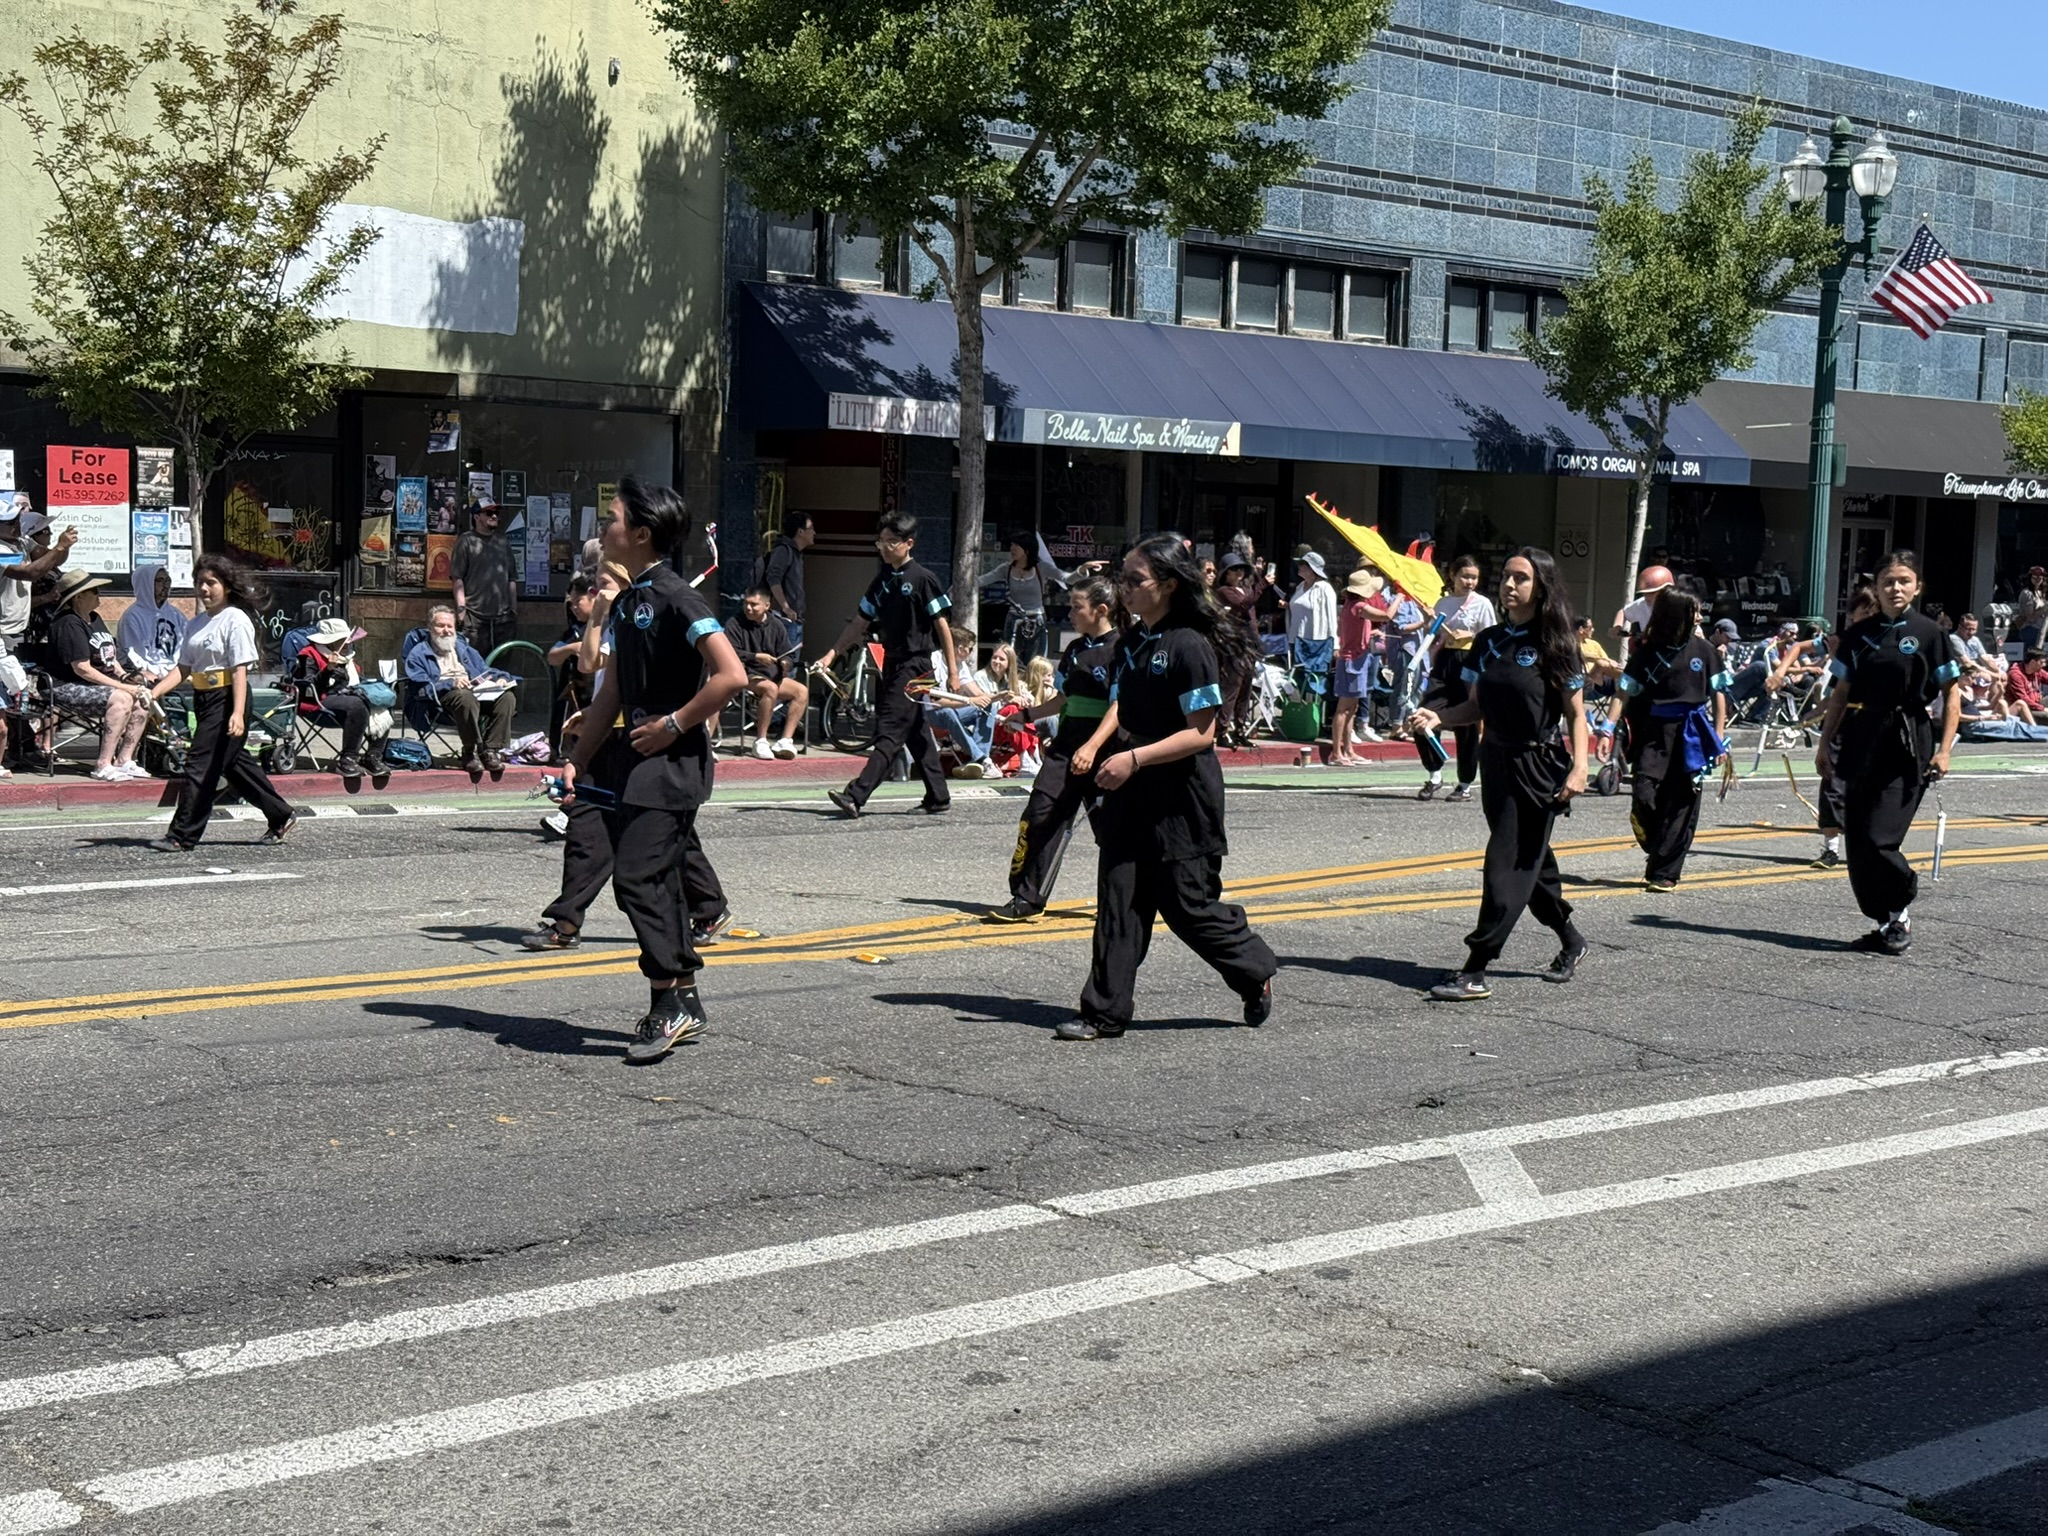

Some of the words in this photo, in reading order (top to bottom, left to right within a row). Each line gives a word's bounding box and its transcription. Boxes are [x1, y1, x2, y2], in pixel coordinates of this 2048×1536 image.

[1048, 413, 1090, 441] Bella
[1092, 416, 1129, 445] Nail
[1129, 422, 1155, 449] Spa
[1158, 421, 1171, 447] &
[1172, 424, 1220, 454] Waxing
[71, 449, 106, 467] For
[1556, 453, 1598, 471] TOMO'S
[1602, 456, 1648, 475] ORGA
[1655, 460, 1679, 475] NAIL
[1681, 461, 1701, 477] SPA
[59, 468, 118, 486] Lease
[52, 489, 125, 501] 415.395.7262
[1943, 472, 2004, 499] Triumphant
[2003, 477, 2025, 502] Life
[2025, 479, 2048, 499] Chu
[57, 514, 79, 522] ustin
[81, 514, 102, 523] Choi
[1066, 525, 1094, 543] TK
[114, 562, 128, 570] JLL
[1699, 601, 1714, 613] day
[1741, 600, 1779, 613] Wednesday
